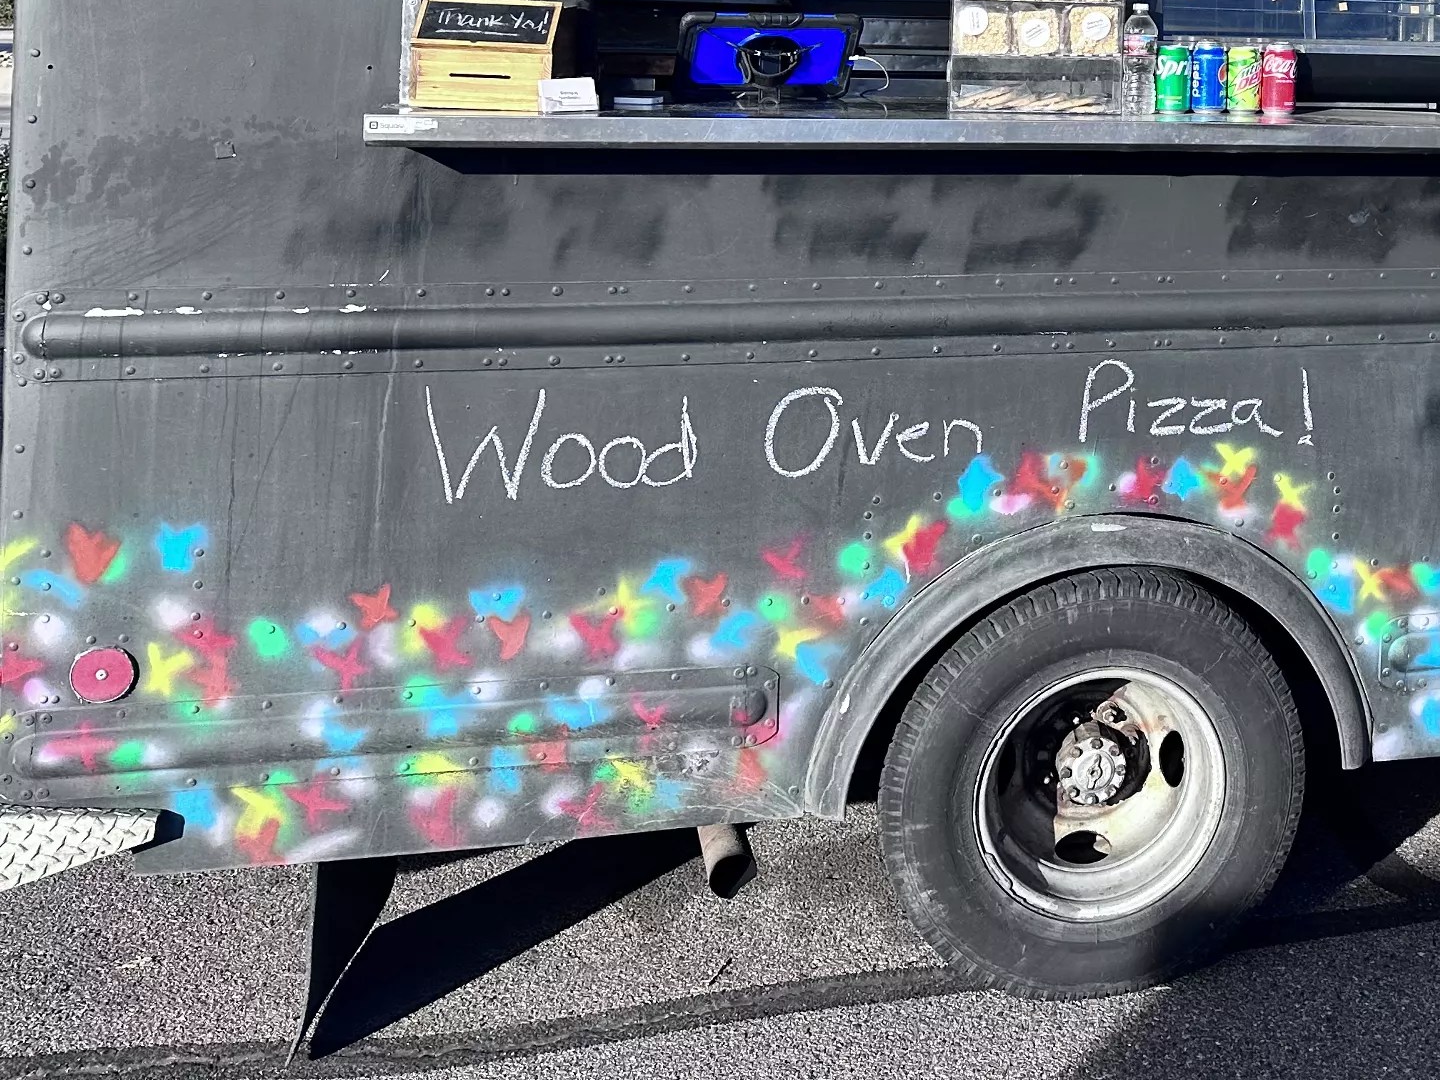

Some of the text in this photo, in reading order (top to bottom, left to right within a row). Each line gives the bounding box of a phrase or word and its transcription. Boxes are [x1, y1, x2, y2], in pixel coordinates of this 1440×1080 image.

[438, 6, 504, 28] Thank
[1192, 60, 1201, 98] pepsi
[425, 358, 1314, 506] Wood Oven Pizza!
